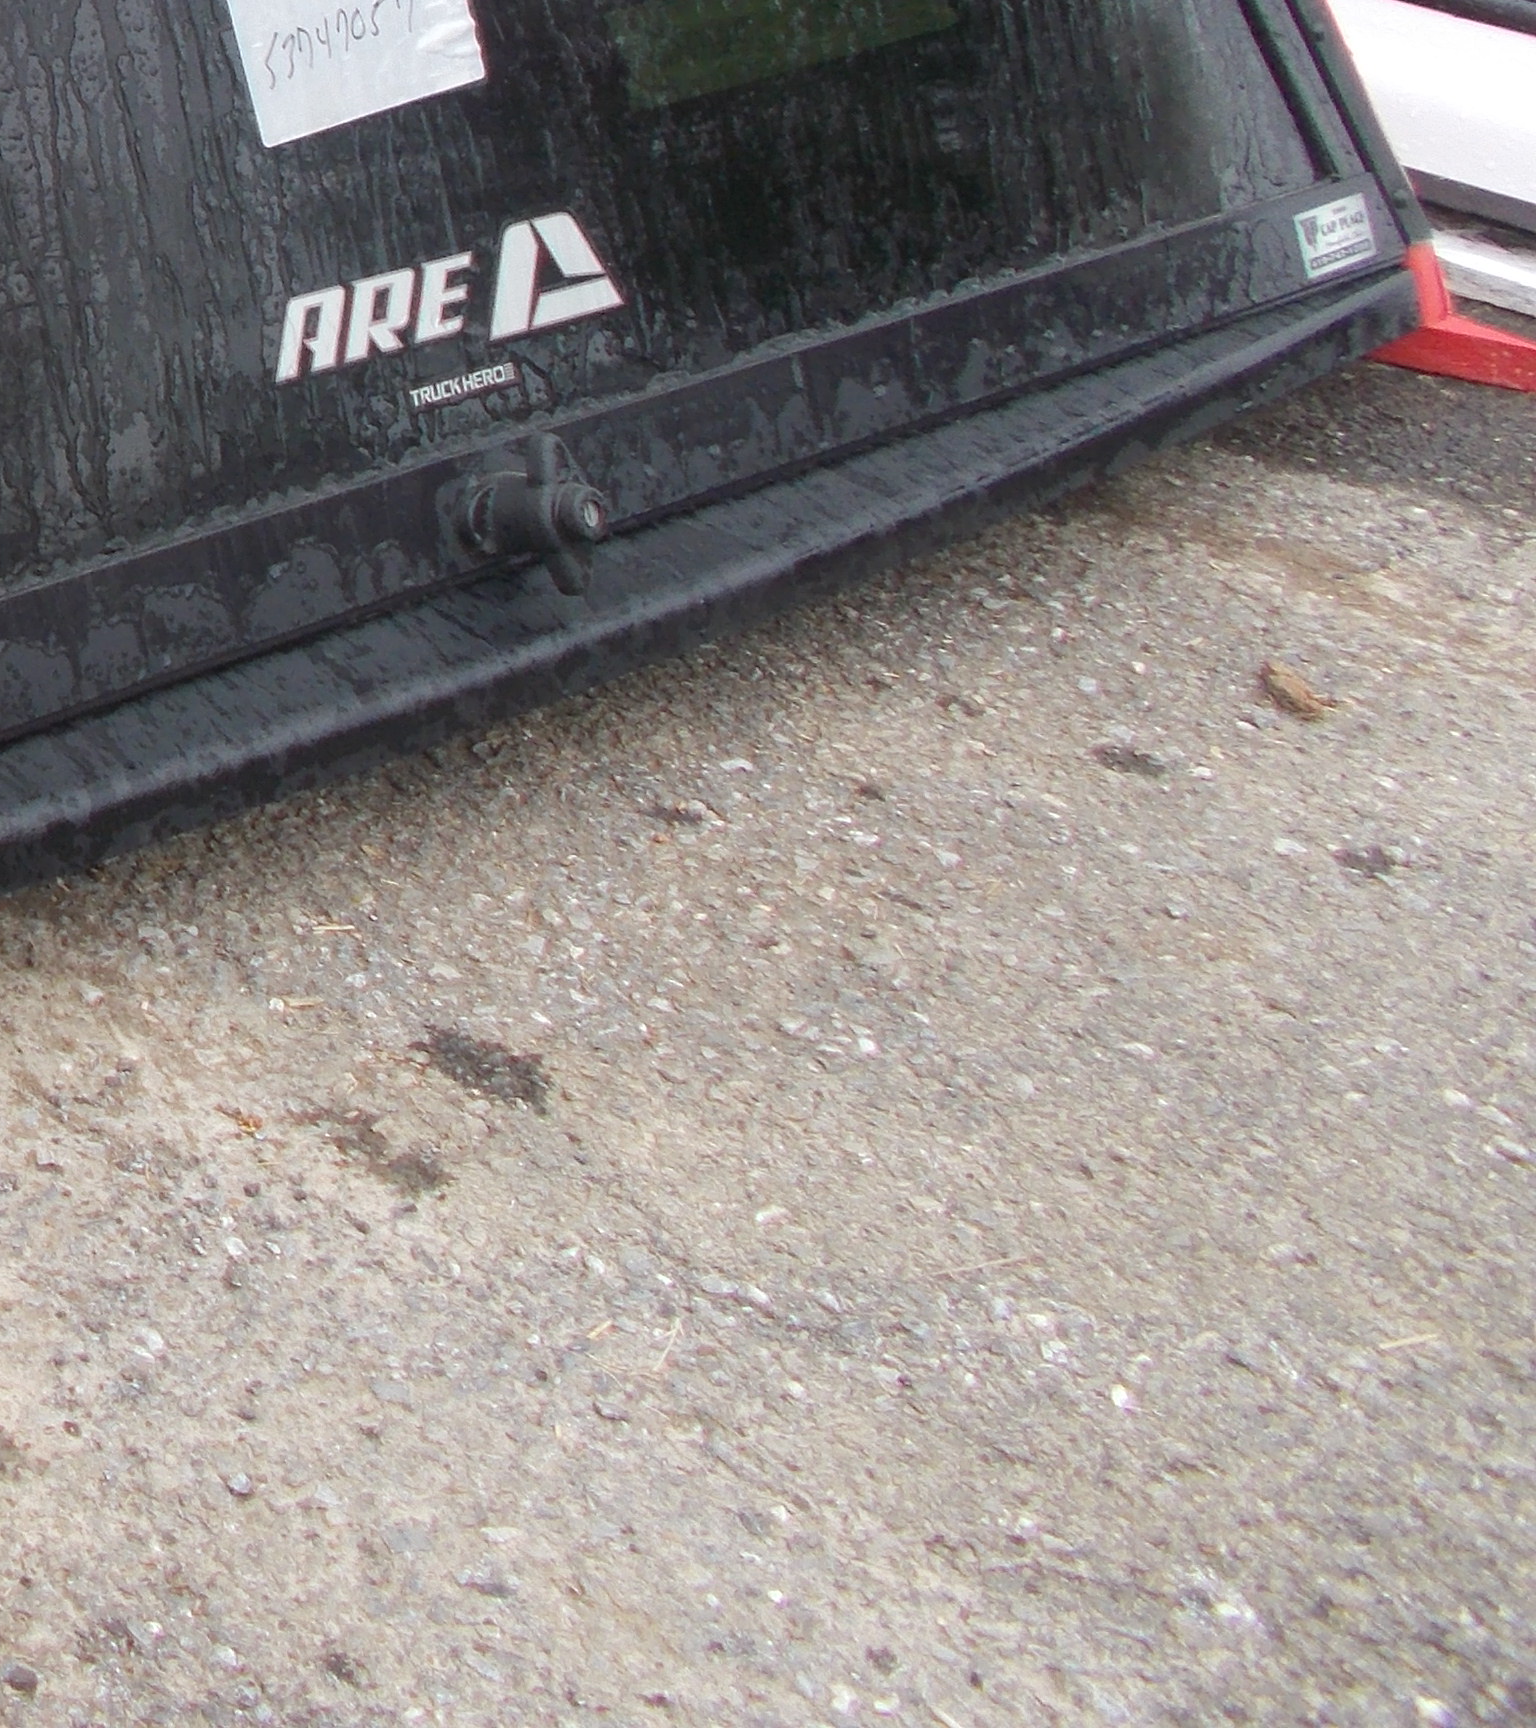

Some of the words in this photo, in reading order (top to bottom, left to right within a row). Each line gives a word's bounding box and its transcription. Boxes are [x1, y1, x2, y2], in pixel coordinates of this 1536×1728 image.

[275, 250, 472, 384] ARE
[409, 376, 461, 407] TRUCK
[462, 365, 506, 392] HERO
